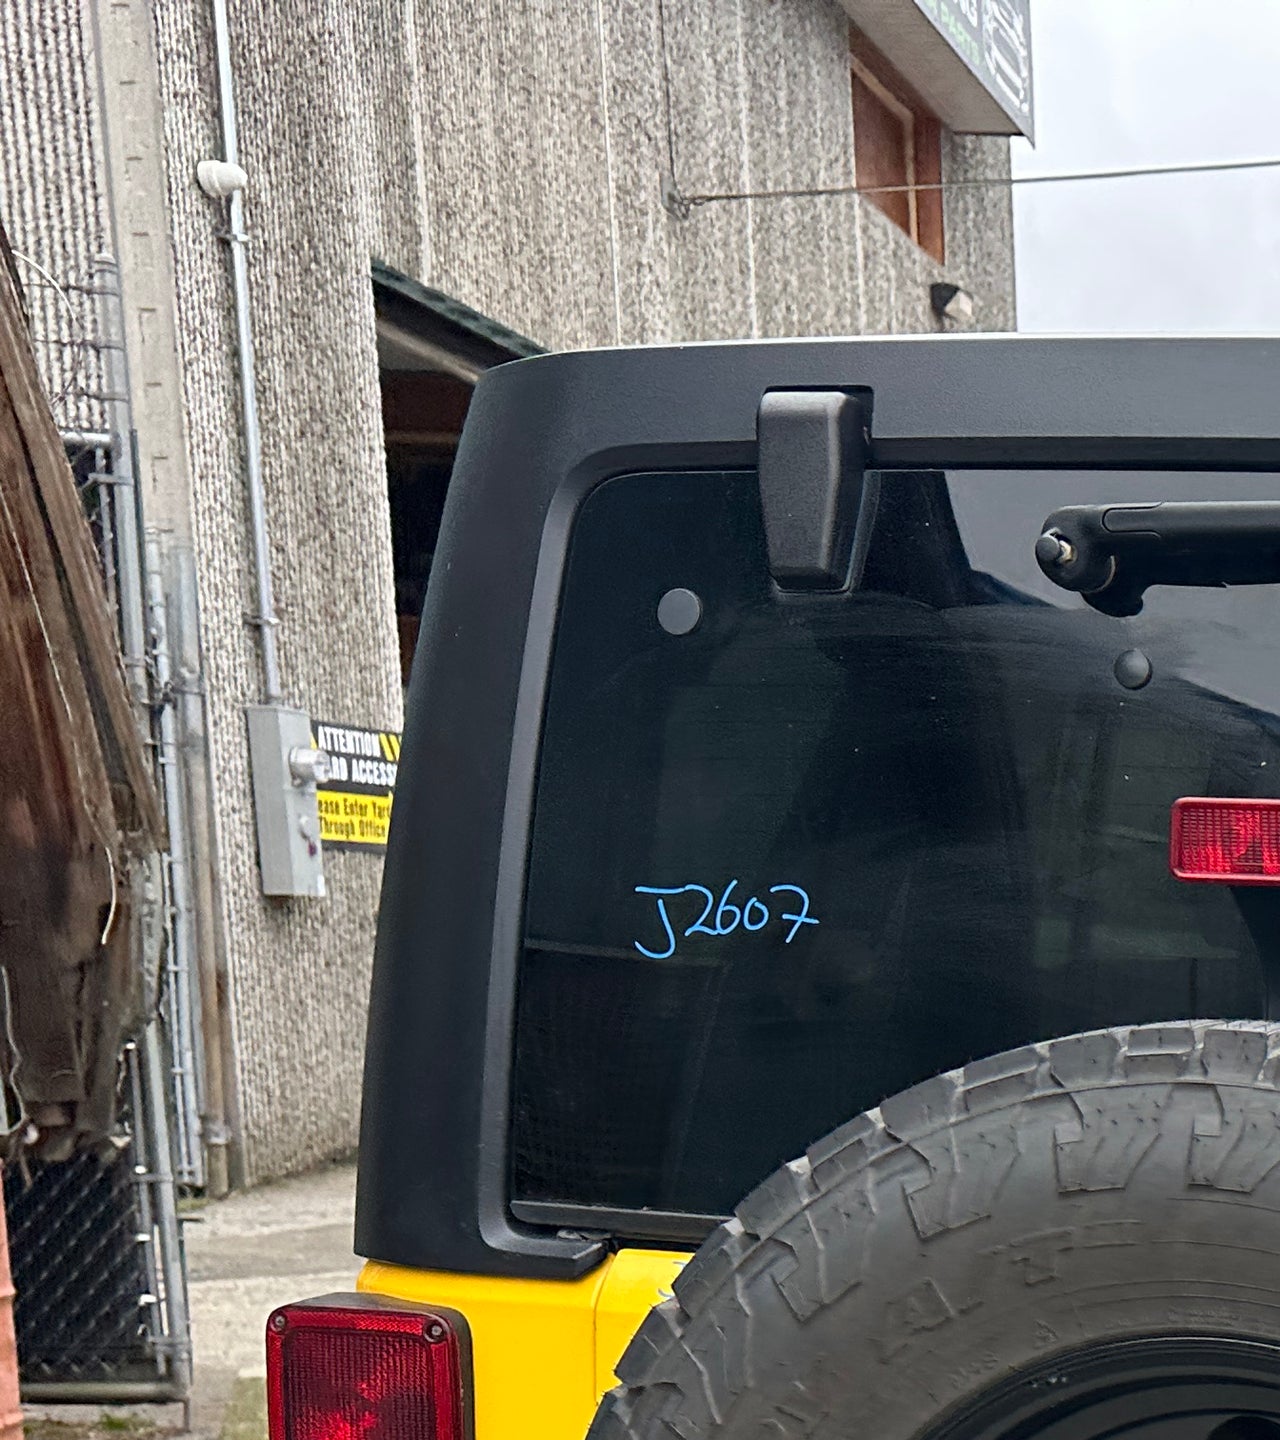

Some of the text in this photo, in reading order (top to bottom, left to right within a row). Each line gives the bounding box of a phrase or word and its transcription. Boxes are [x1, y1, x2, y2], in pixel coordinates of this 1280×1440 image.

[318, 726, 380, 758] ATTENTION
[343, 798, 368, 817] Enter
[318, 815, 386, 839] Through Office
[635, 879, 820, 959] J2607
